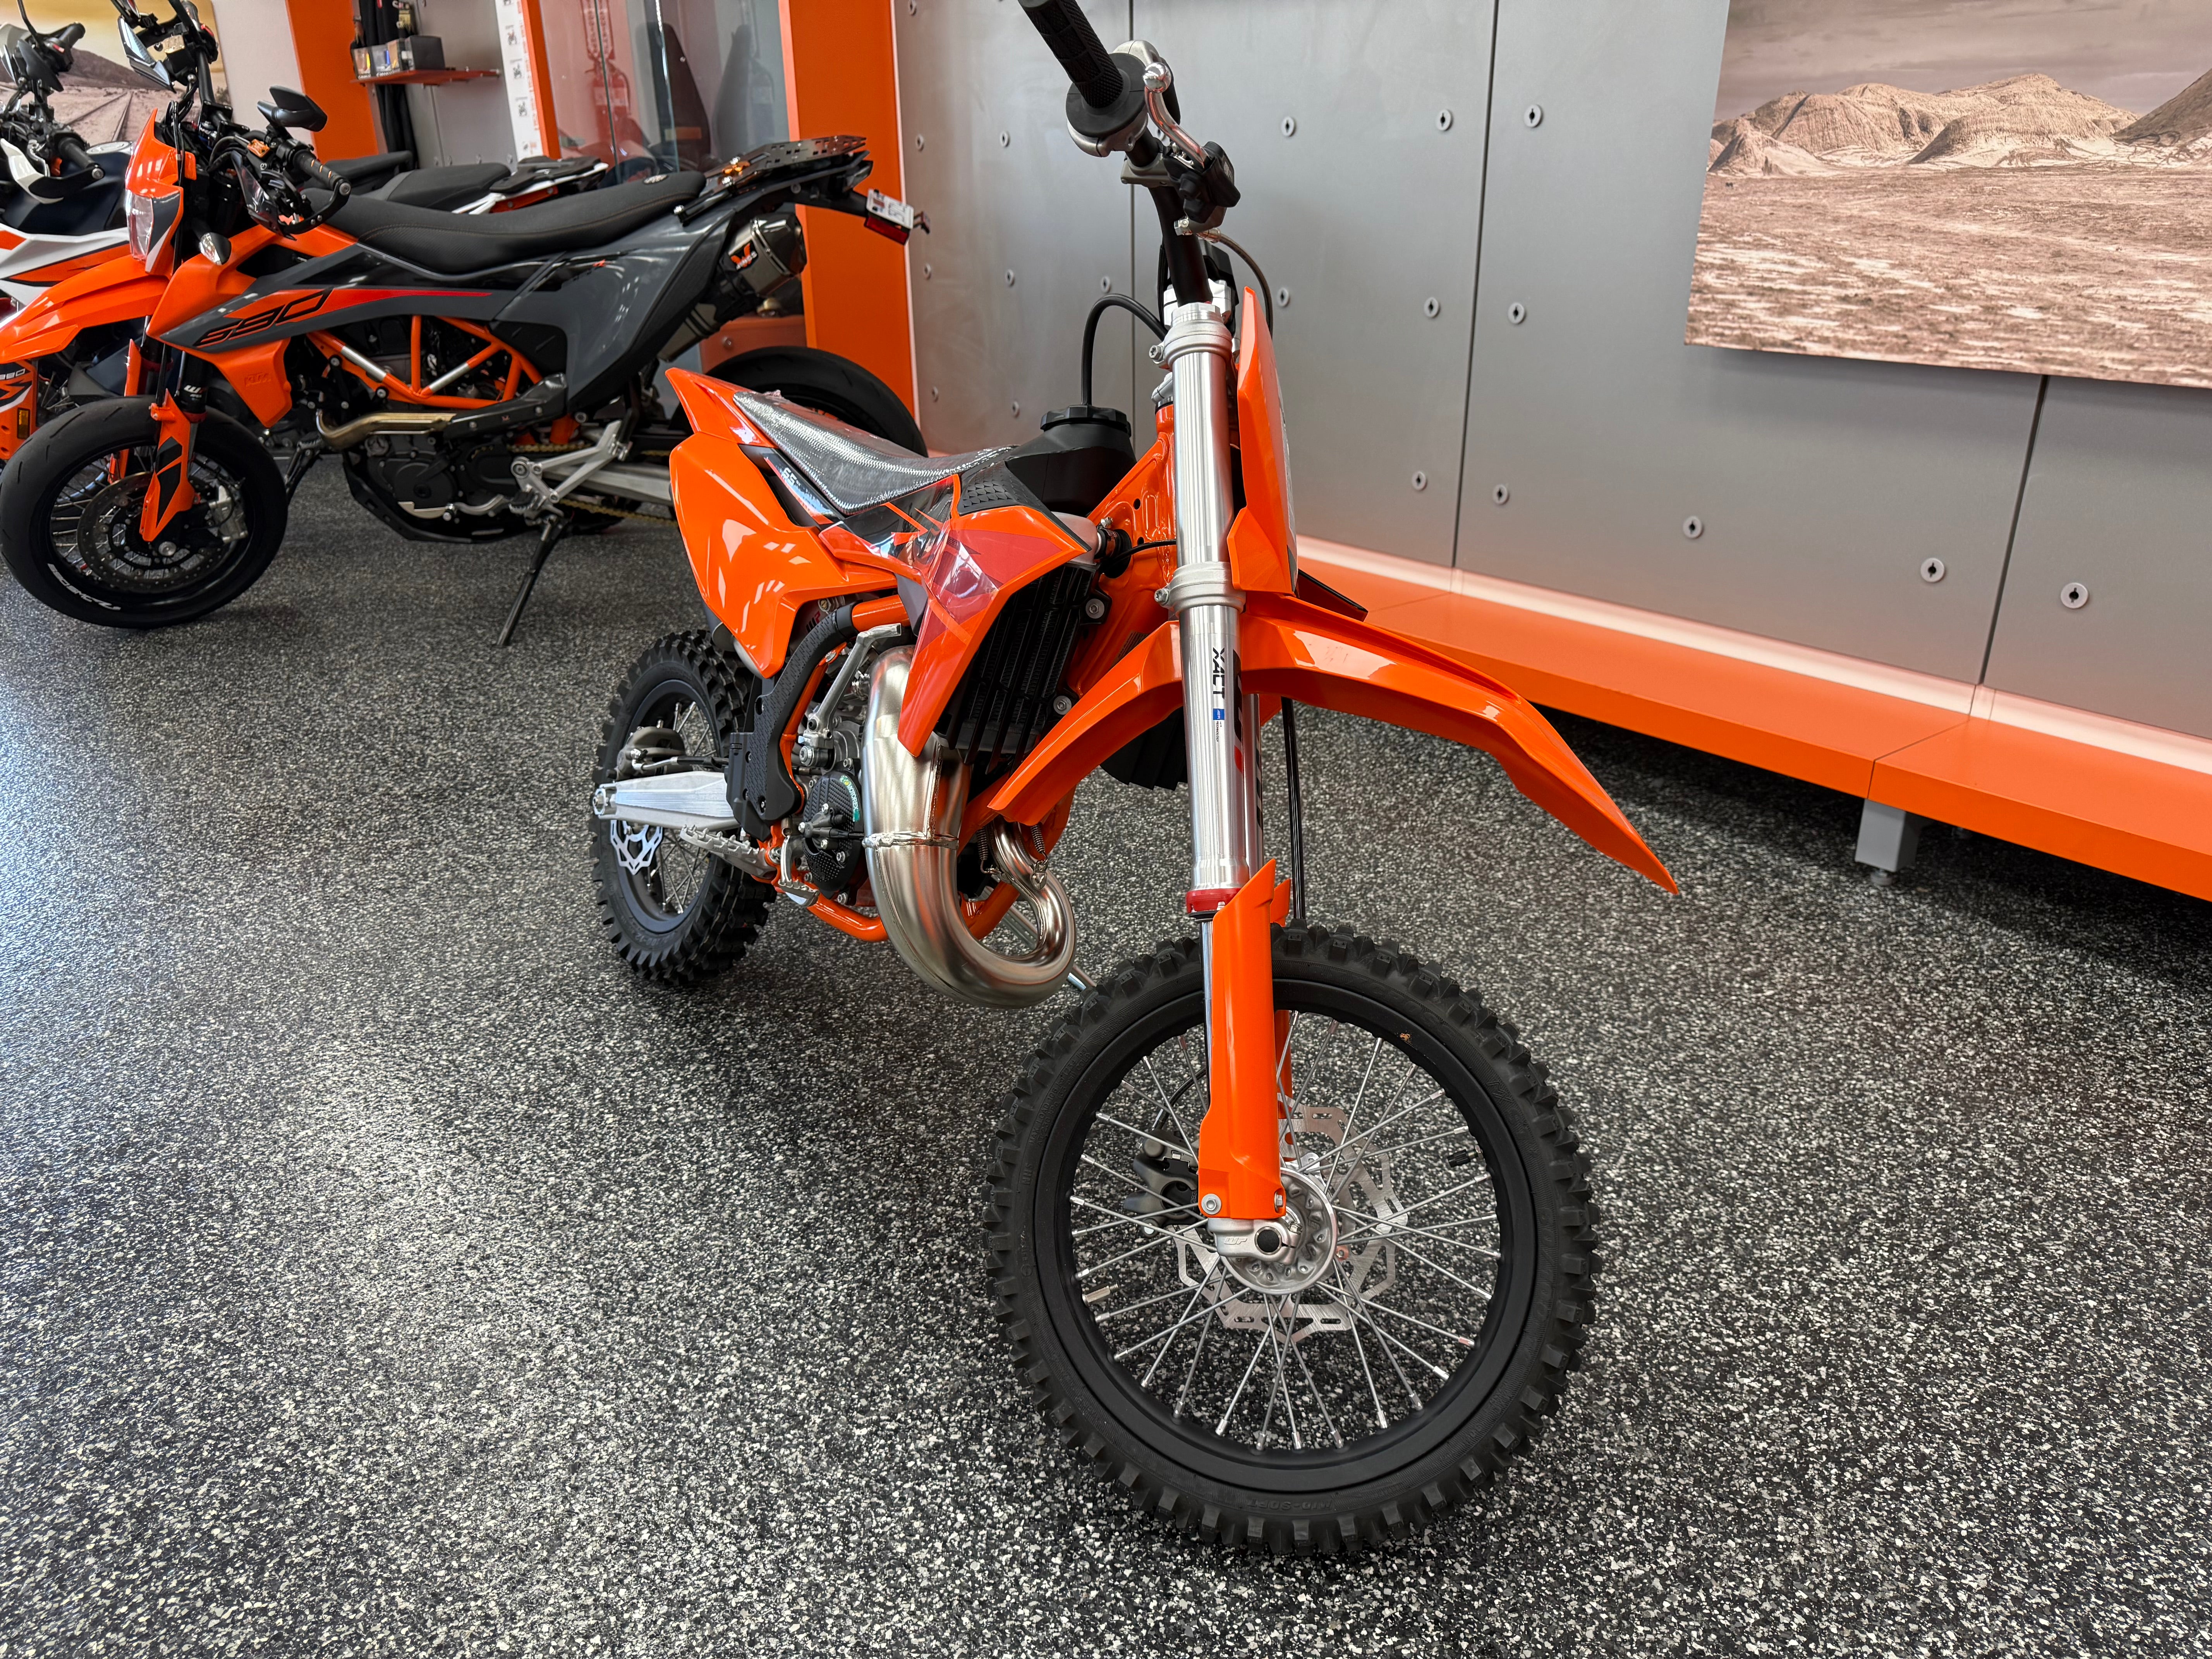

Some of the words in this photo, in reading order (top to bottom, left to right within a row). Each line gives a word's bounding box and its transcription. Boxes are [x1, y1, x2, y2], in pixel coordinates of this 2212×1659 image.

[193, 289, 334, 348] 690
[781, 467, 797, 486] 65
[1212, 647, 1225, 699] XACT
[846, 784, 859, 813] MOTOREX
[1035, 1101, 1051, 1125] LOAD
[1223, 1237, 1248, 1245] WP
[1246, 1496, 1334, 1511] MID-SOFT
